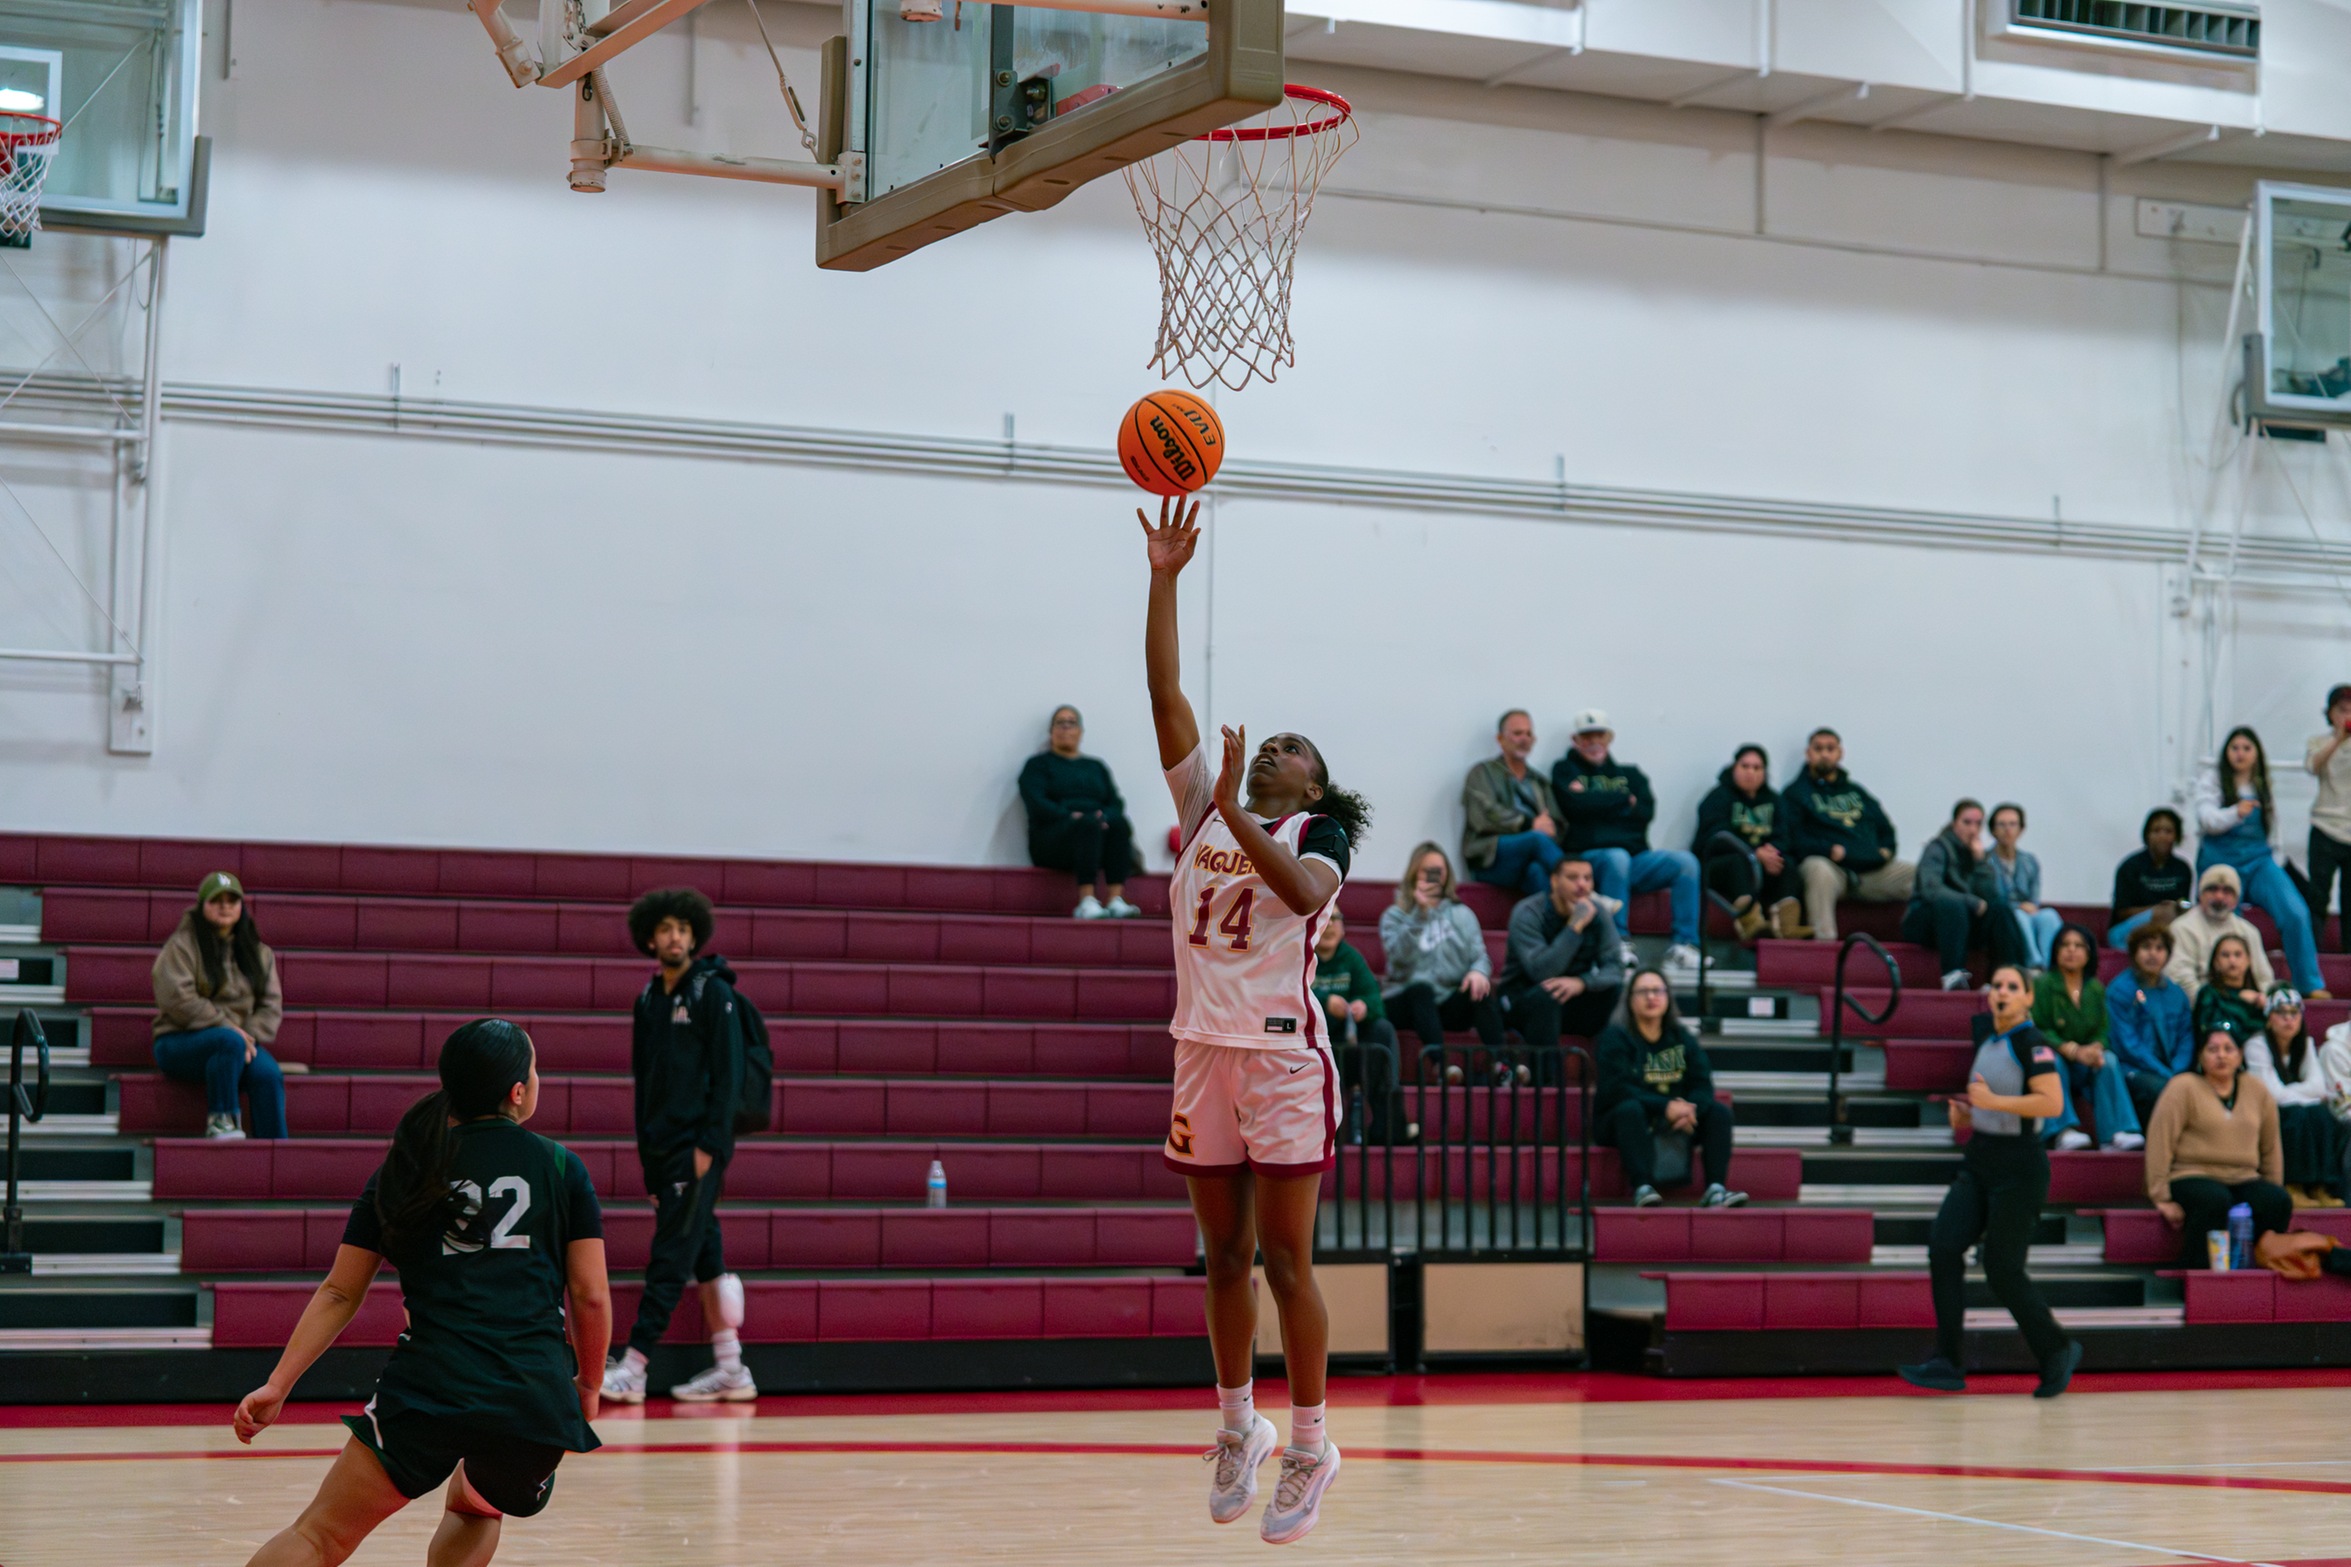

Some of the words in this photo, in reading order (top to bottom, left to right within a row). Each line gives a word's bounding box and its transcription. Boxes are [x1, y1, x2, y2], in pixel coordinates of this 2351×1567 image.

[1150, 415, 1196, 482] Wilson
[1183, 409, 1216, 446] EVO
[1194, 842, 1256, 876] VAQUE
[1188, 884, 1256, 954] 14
[1168, 1111, 1196, 1158] G
